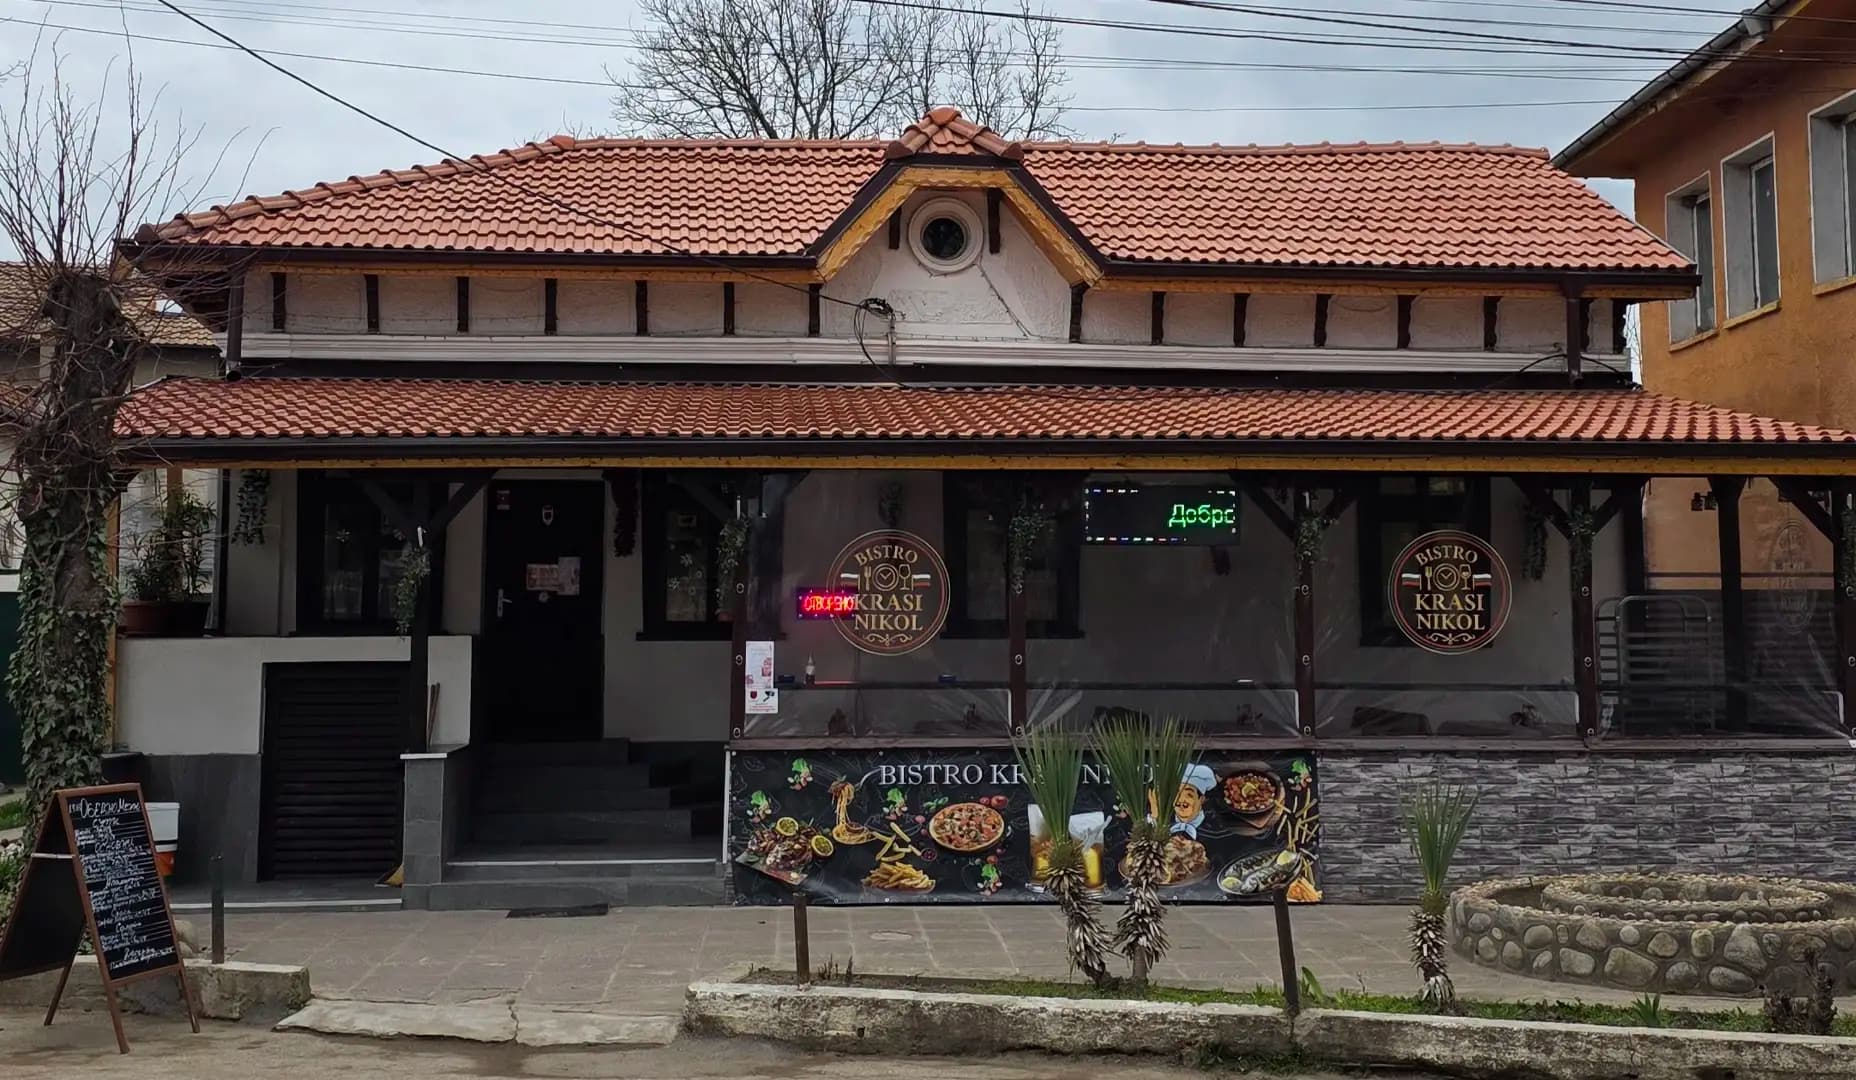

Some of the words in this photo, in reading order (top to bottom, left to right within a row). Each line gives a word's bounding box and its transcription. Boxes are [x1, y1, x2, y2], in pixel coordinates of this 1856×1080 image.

[854, 545, 918, 566] BISTRO
[1415, 545, 1478, 566] BISTRO
[855, 594, 923, 611] KRASI
[1415, 593, 1485, 611] KRASI
[854, 615, 923, 631] NIKOL
[1416, 613, 1485, 630] NIKOL
[879, 764, 982, 785] BISTRO
